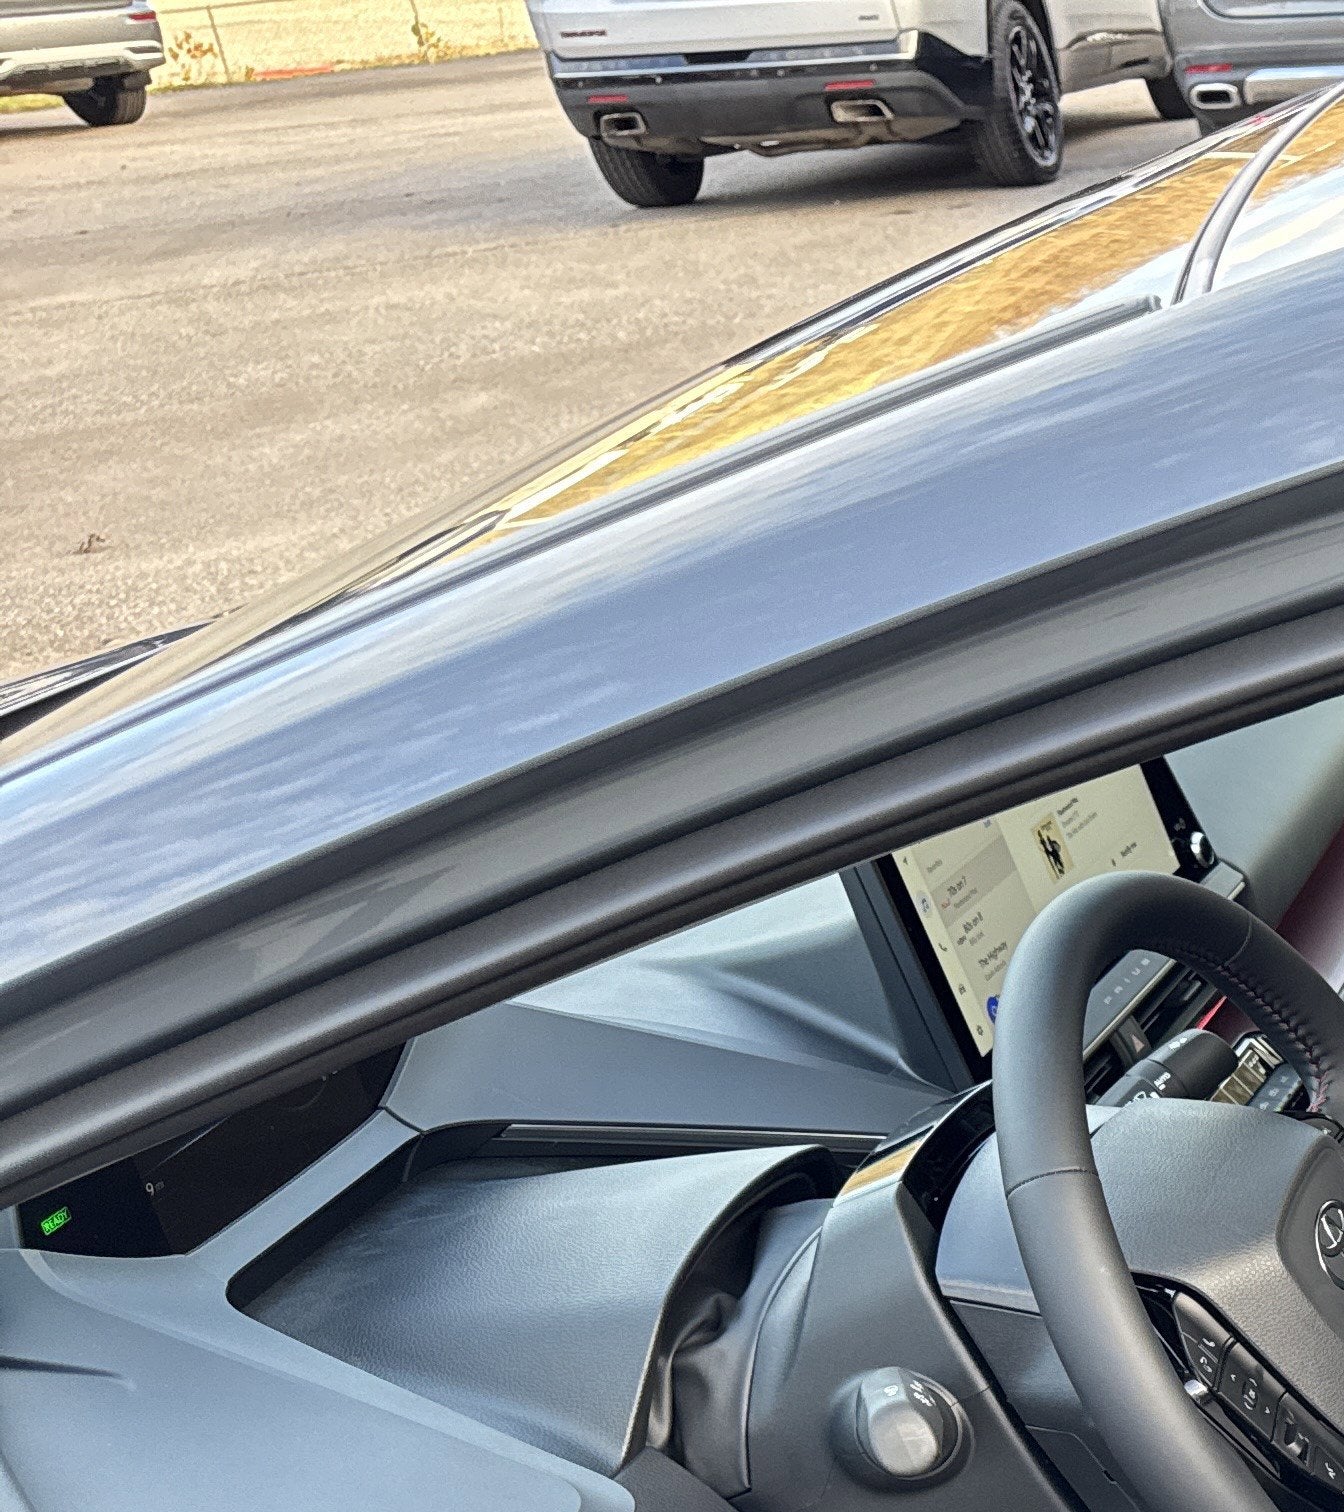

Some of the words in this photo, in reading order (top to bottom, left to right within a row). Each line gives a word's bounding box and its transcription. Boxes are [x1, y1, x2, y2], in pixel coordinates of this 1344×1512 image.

[1103, 958, 1151, 1005] PRIUS
[145, 1182, 154, 1196] 9
[43, 1208, 69, 1232] READY
